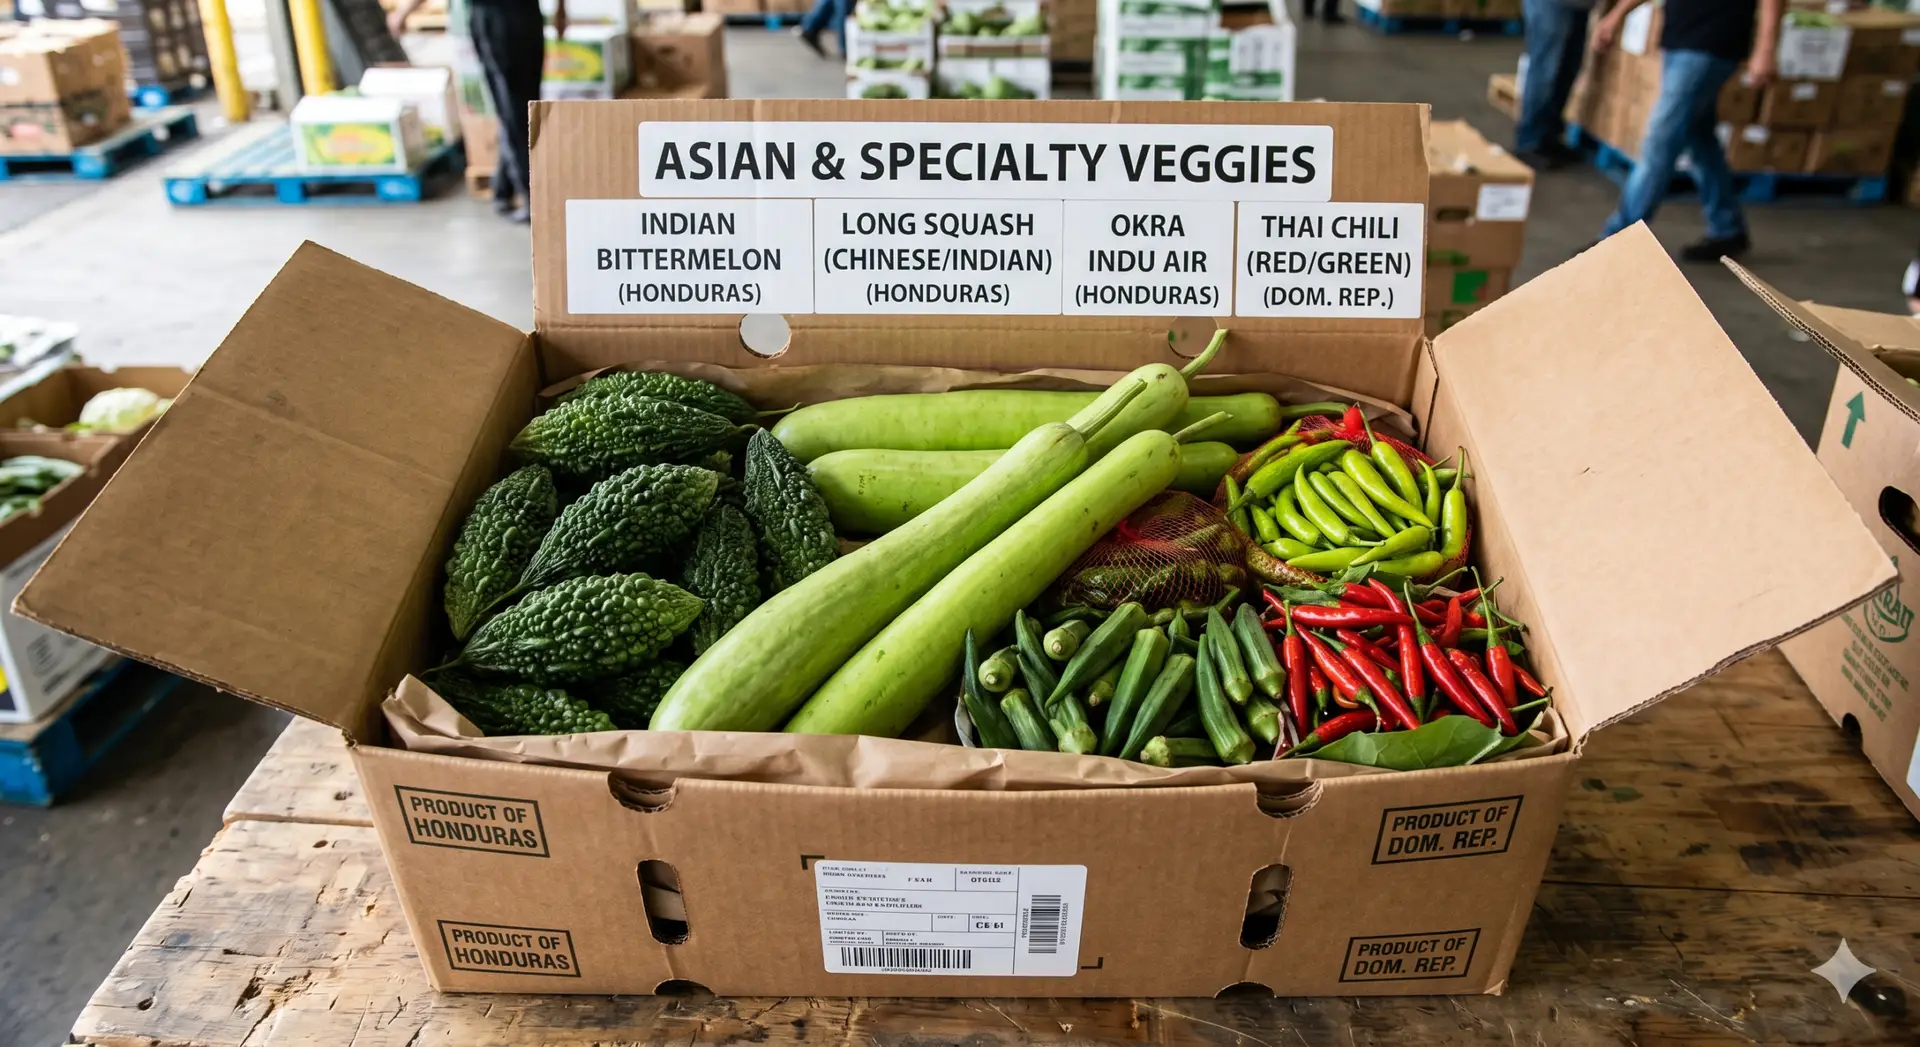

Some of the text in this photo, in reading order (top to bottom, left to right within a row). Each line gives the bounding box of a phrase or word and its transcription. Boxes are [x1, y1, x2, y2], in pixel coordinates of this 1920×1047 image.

[655, 141, 1316, 184] ASIAN & SPECIALTY VEGGIES
[641, 212, 735, 235] INDIAN
[842, 212, 1034, 238] LONG SQUASH
[1111, 213, 1186, 237] OKRA
[1261, 215, 1399, 239] THAI CHILI
[597, 248, 781, 271] BITTERMELON
[824, 247, 1053, 275] (CHINESE/INDIAN)
[1089, 249, 1207, 273] INDU AIR
[1247, 250, 1411, 277] (RED/GREEN)
[618, 282, 762, 306] (HONDURAS)
[866, 283, 1010, 307] (HONDURAS)
[1075, 284, 1219, 309] (HONDURAS)
[1263, 286, 1395, 310] (DOM. REP.)
[411, 795, 527, 824] PRODUCT OF
[1392, 805, 1510, 832] PRODUCT OF
[413, 817, 538, 849] HONDURAS
[1387, 827, 1498, 856] DOM. REP.
[451, 928, 562, 950] PRODUCT OF
[1357, 936, 1467, 957] PRODUCT OF
[454, 946, 570, 970] HONDURAS
[1354, 954, 1456, 976] DOM. REP.
